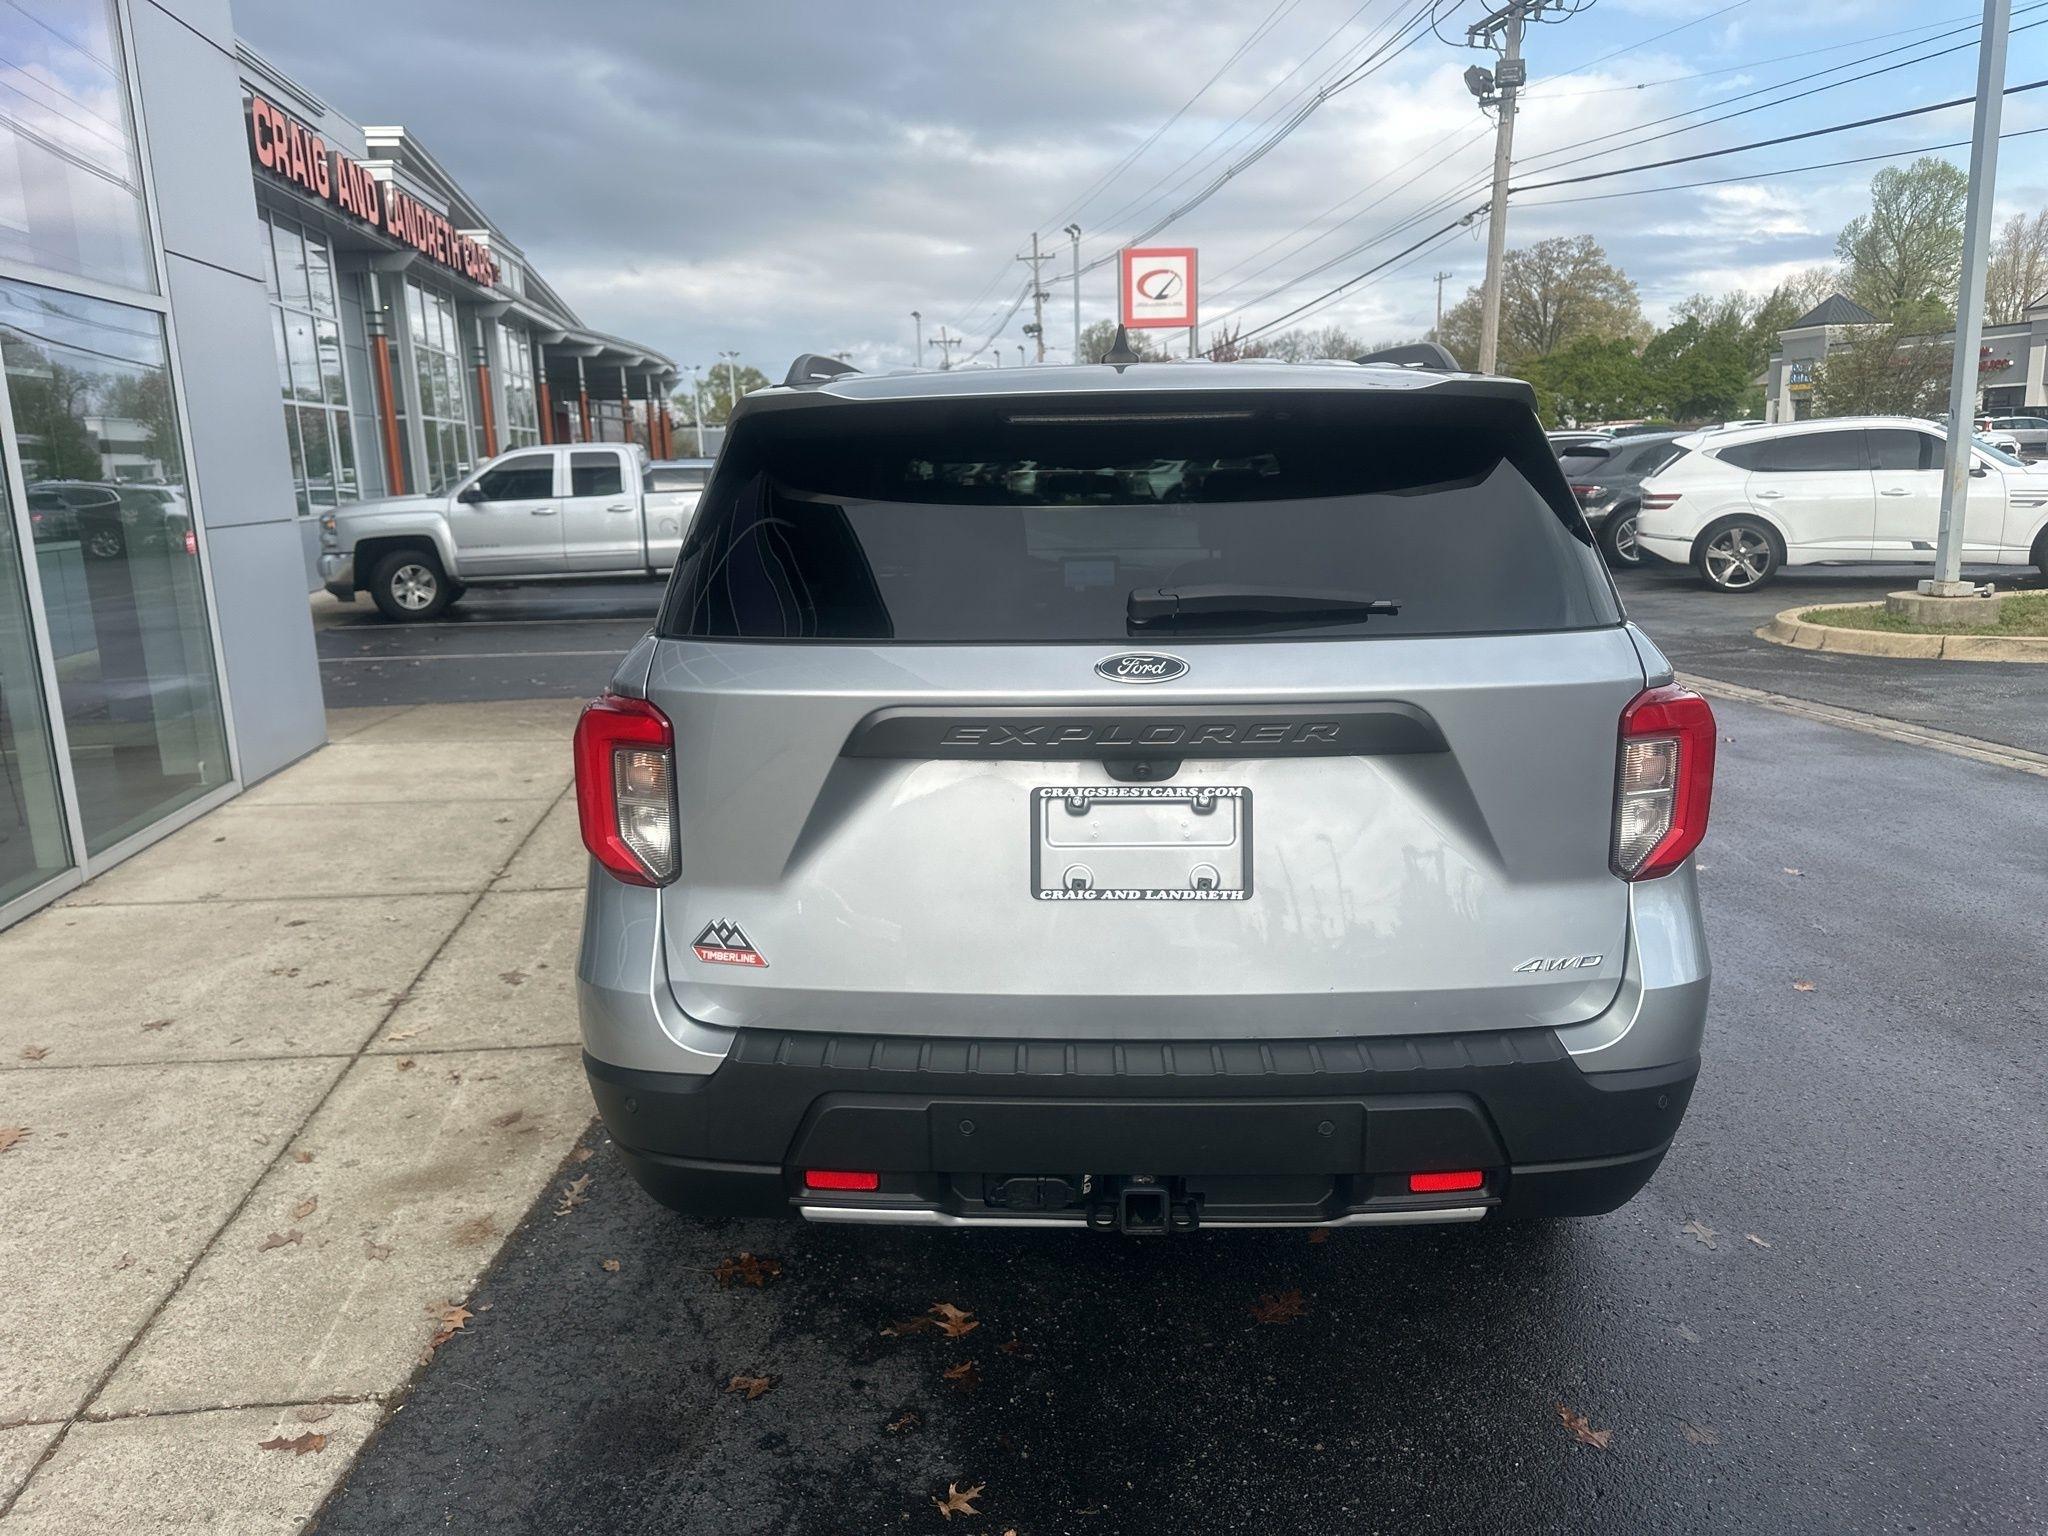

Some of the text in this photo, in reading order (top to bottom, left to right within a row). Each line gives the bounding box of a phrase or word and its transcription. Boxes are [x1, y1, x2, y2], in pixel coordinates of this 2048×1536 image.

[252, 96, 330, 199] CRAIG
[335, 153, 380, 226] AND
[382, 182, 462, 271] LANDRETH
[1117, 657, 1167, 675] Ford
[940, 721, 1344, 746] EXPLORER
[1039, 787, 1244, 797] CRAIGSBESTCARS.COM
[1039, 890, 1245, 900] CRAIG AND LANDRETH
[701, 950, 757, 963] TIMBERLINE
[1512, 954, 1604, 973] 4WD
